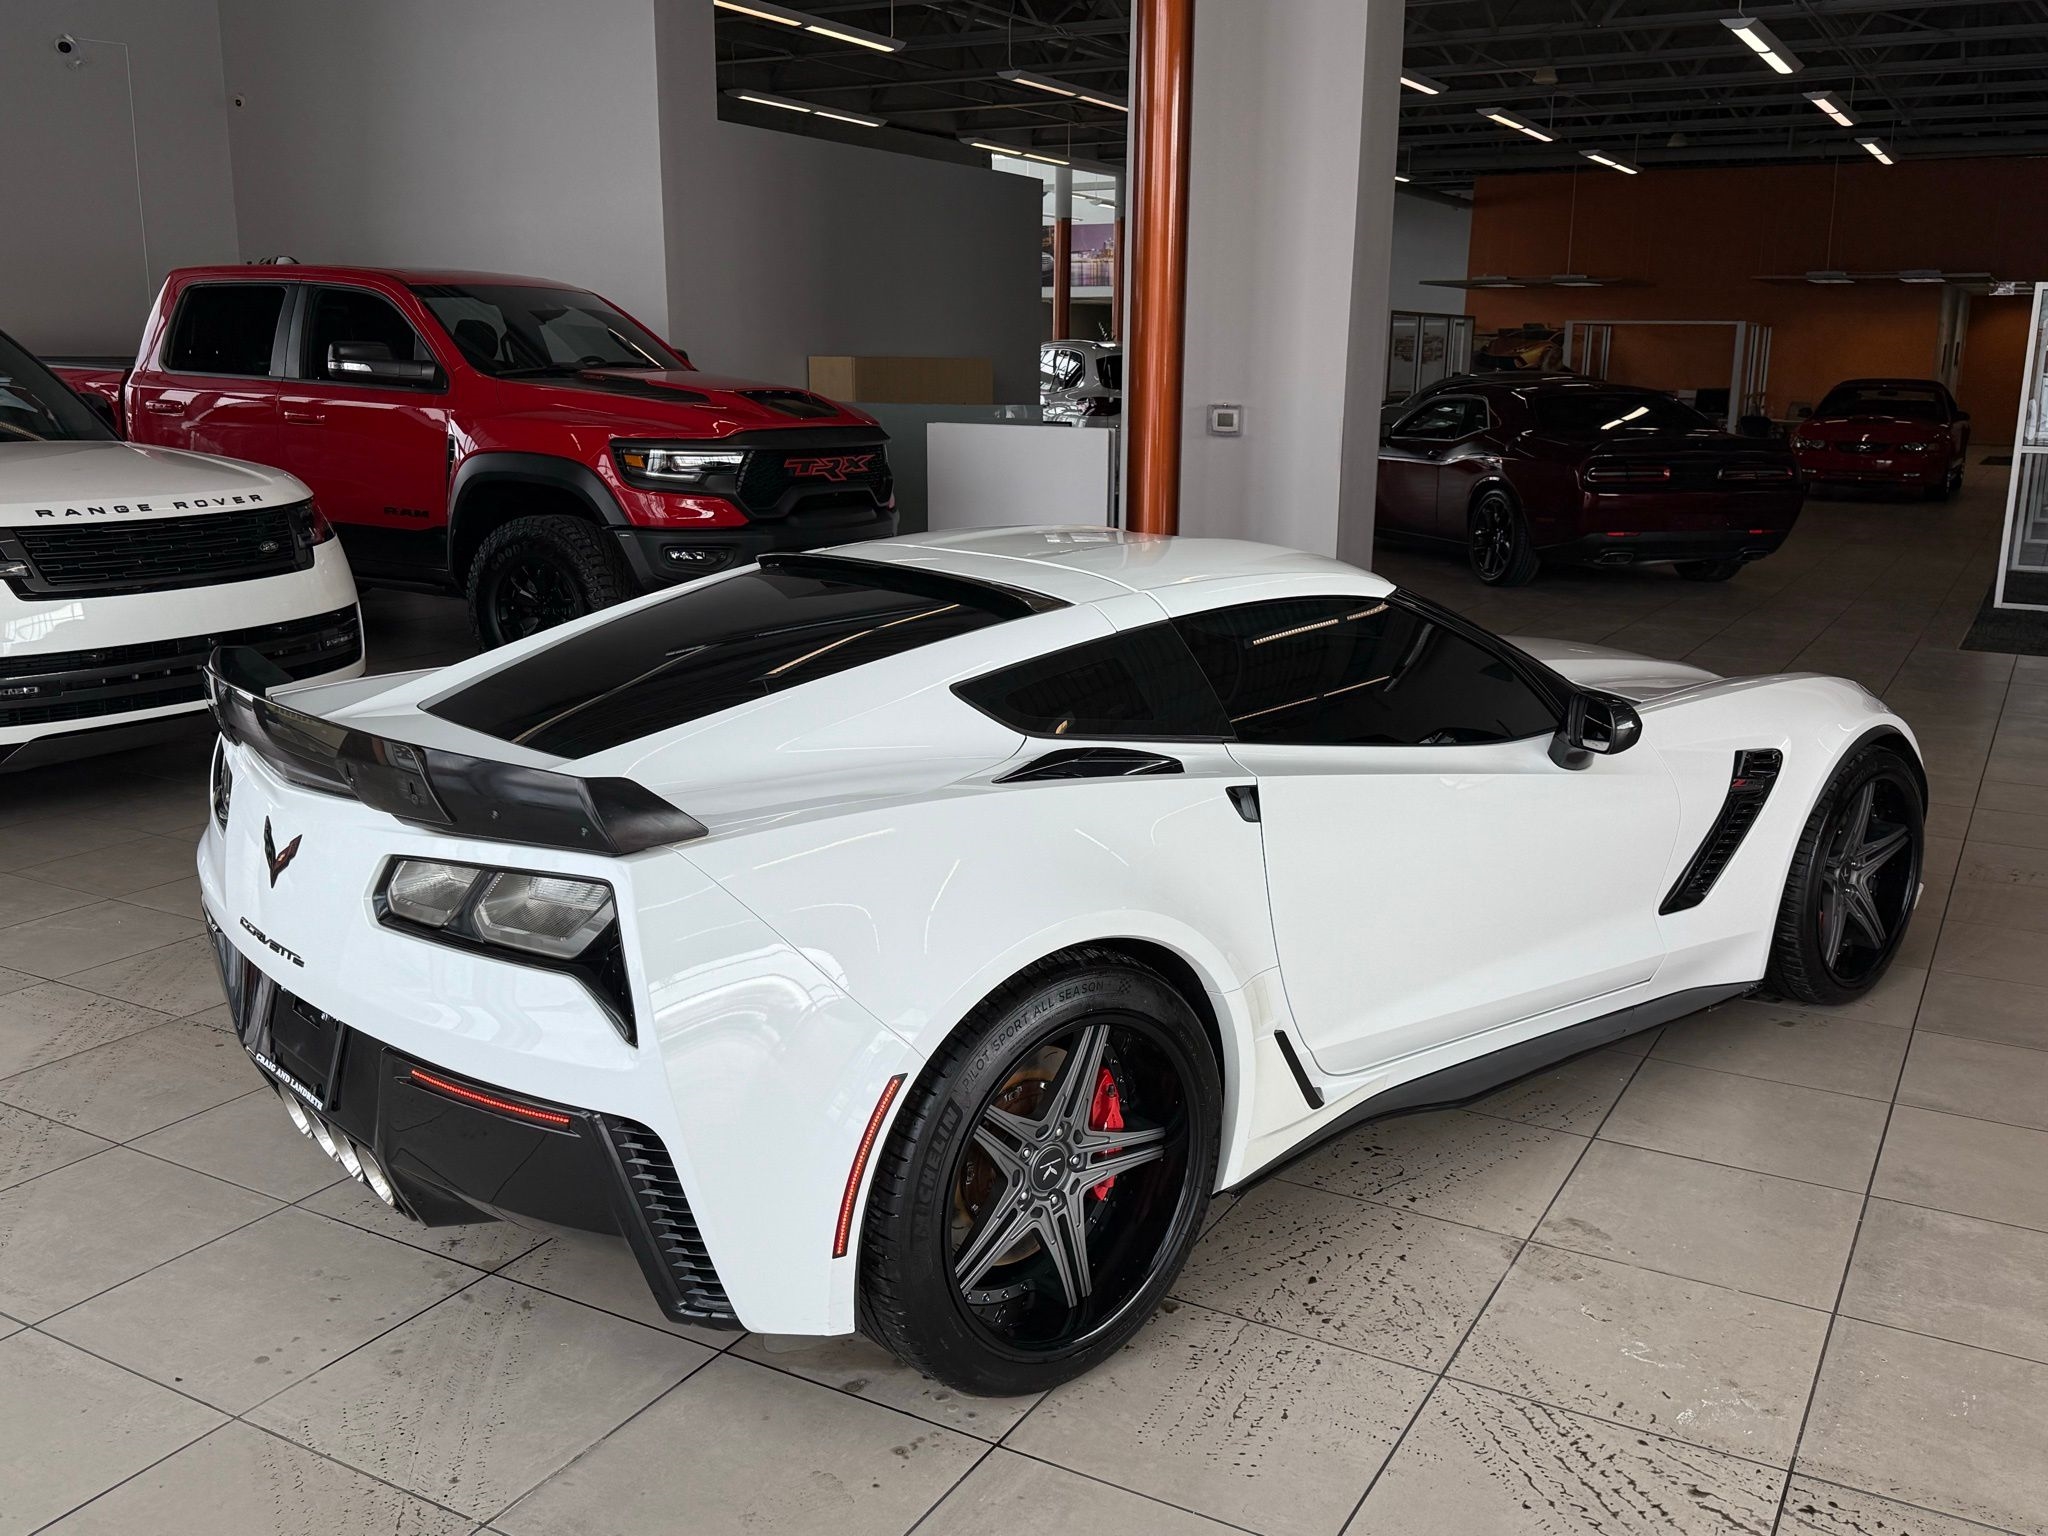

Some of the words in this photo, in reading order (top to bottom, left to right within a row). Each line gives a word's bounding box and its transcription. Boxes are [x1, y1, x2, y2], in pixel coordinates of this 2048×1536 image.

[784, 454, 876, 481] TRX
[35, 503, 153, 518] RANGE
[173, 494, 264, 511] ROVER
[384, 506, 429, 520] RAM
[240, 916, 305, 968] CORVETTE
[961, 1049, 990, 1091] PILOT
[992, 1012, 1028, 1052] SPORT
[1033, 997, 1055, 1018] ALL
[1058, 981, 1104, 1003] SEASON
[255, 1053, 276, 1072] CRAIG
[275, 1068, 291, 1083] AND
[289, 1078, 323, 1111] LANDRETH
